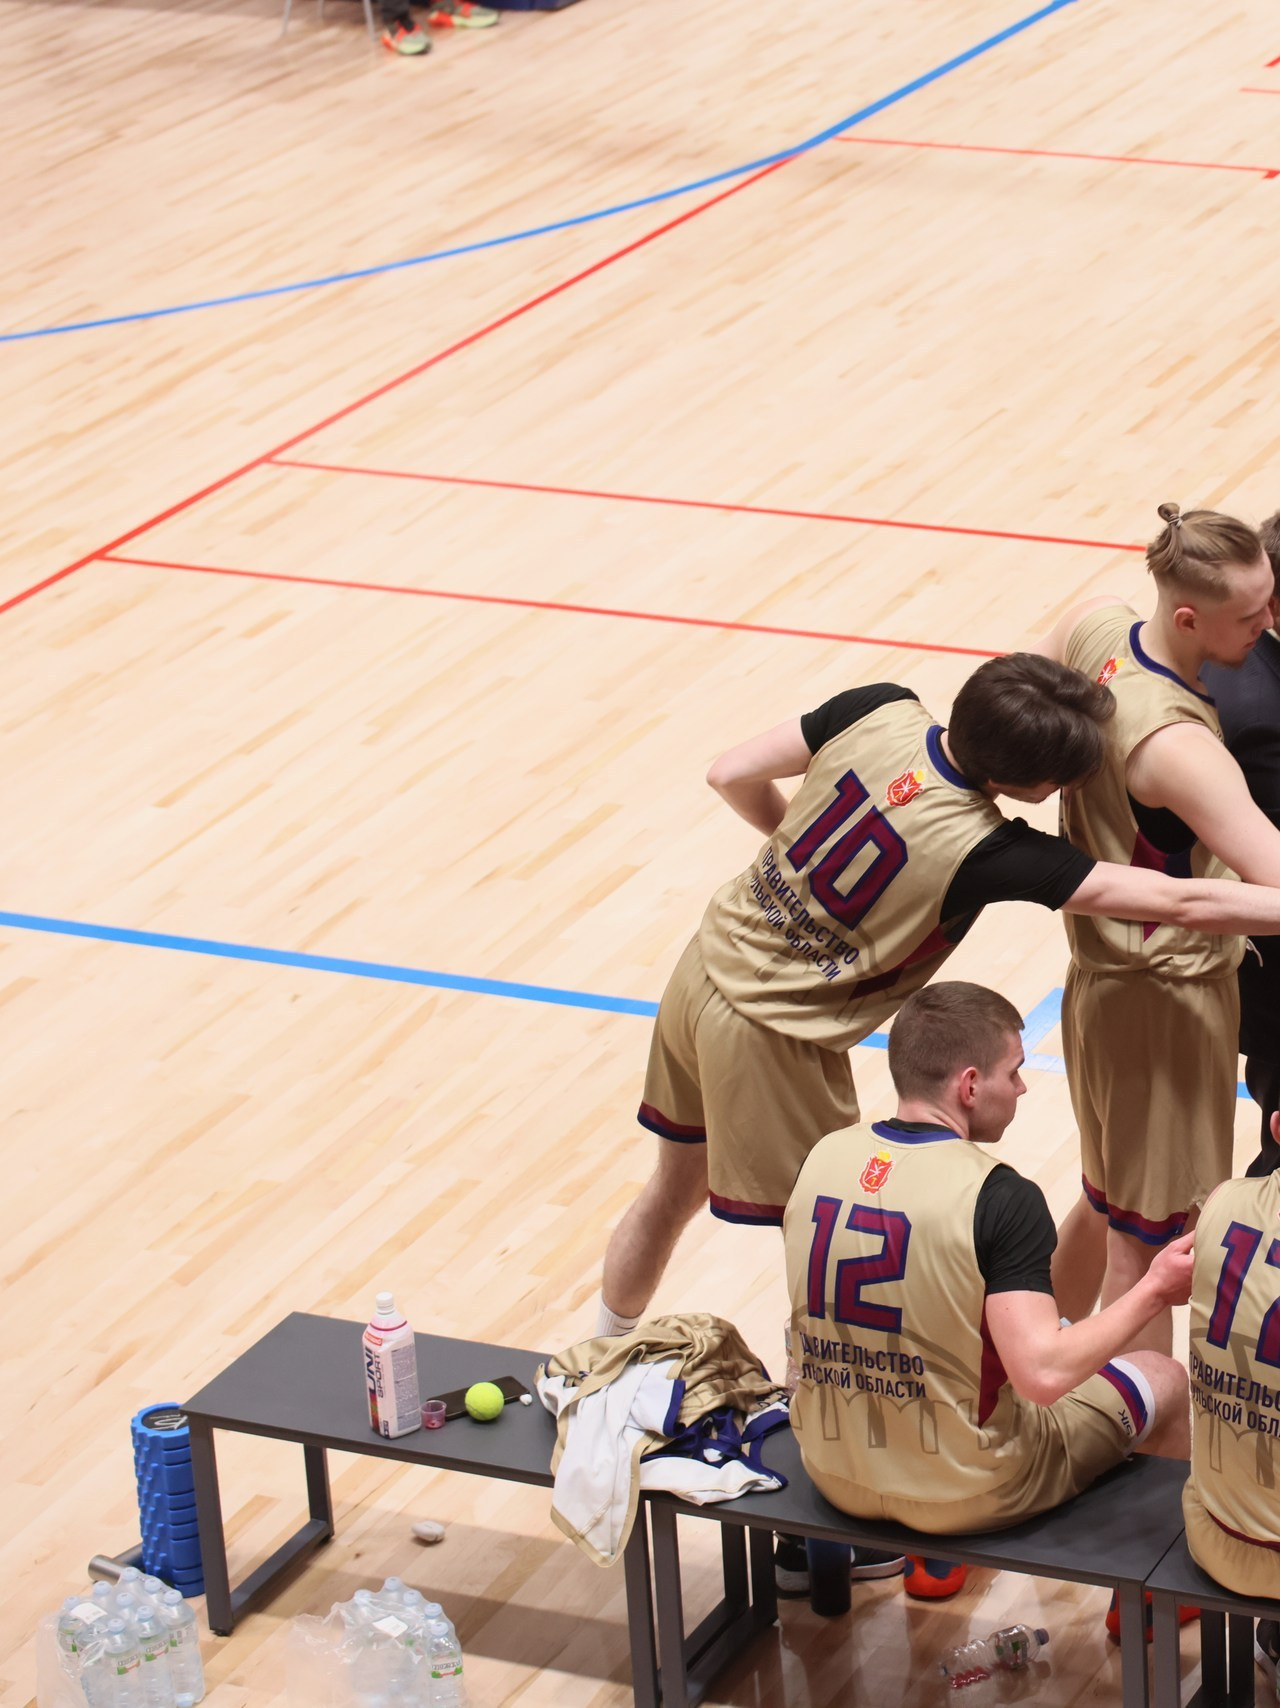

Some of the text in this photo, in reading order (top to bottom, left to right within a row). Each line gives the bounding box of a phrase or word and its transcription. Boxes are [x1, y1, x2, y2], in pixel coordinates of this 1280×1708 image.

[762, 846, 860, 965] ПРАВИТЕЛЬСТВО
[785, 768, 909, 932] 10
[785, 928, 842, 981] ОБЛАСТИ
[806, 1194, 912, 1334] 12
[855, 1373, 927, 1398] ОБЛАСТИ
